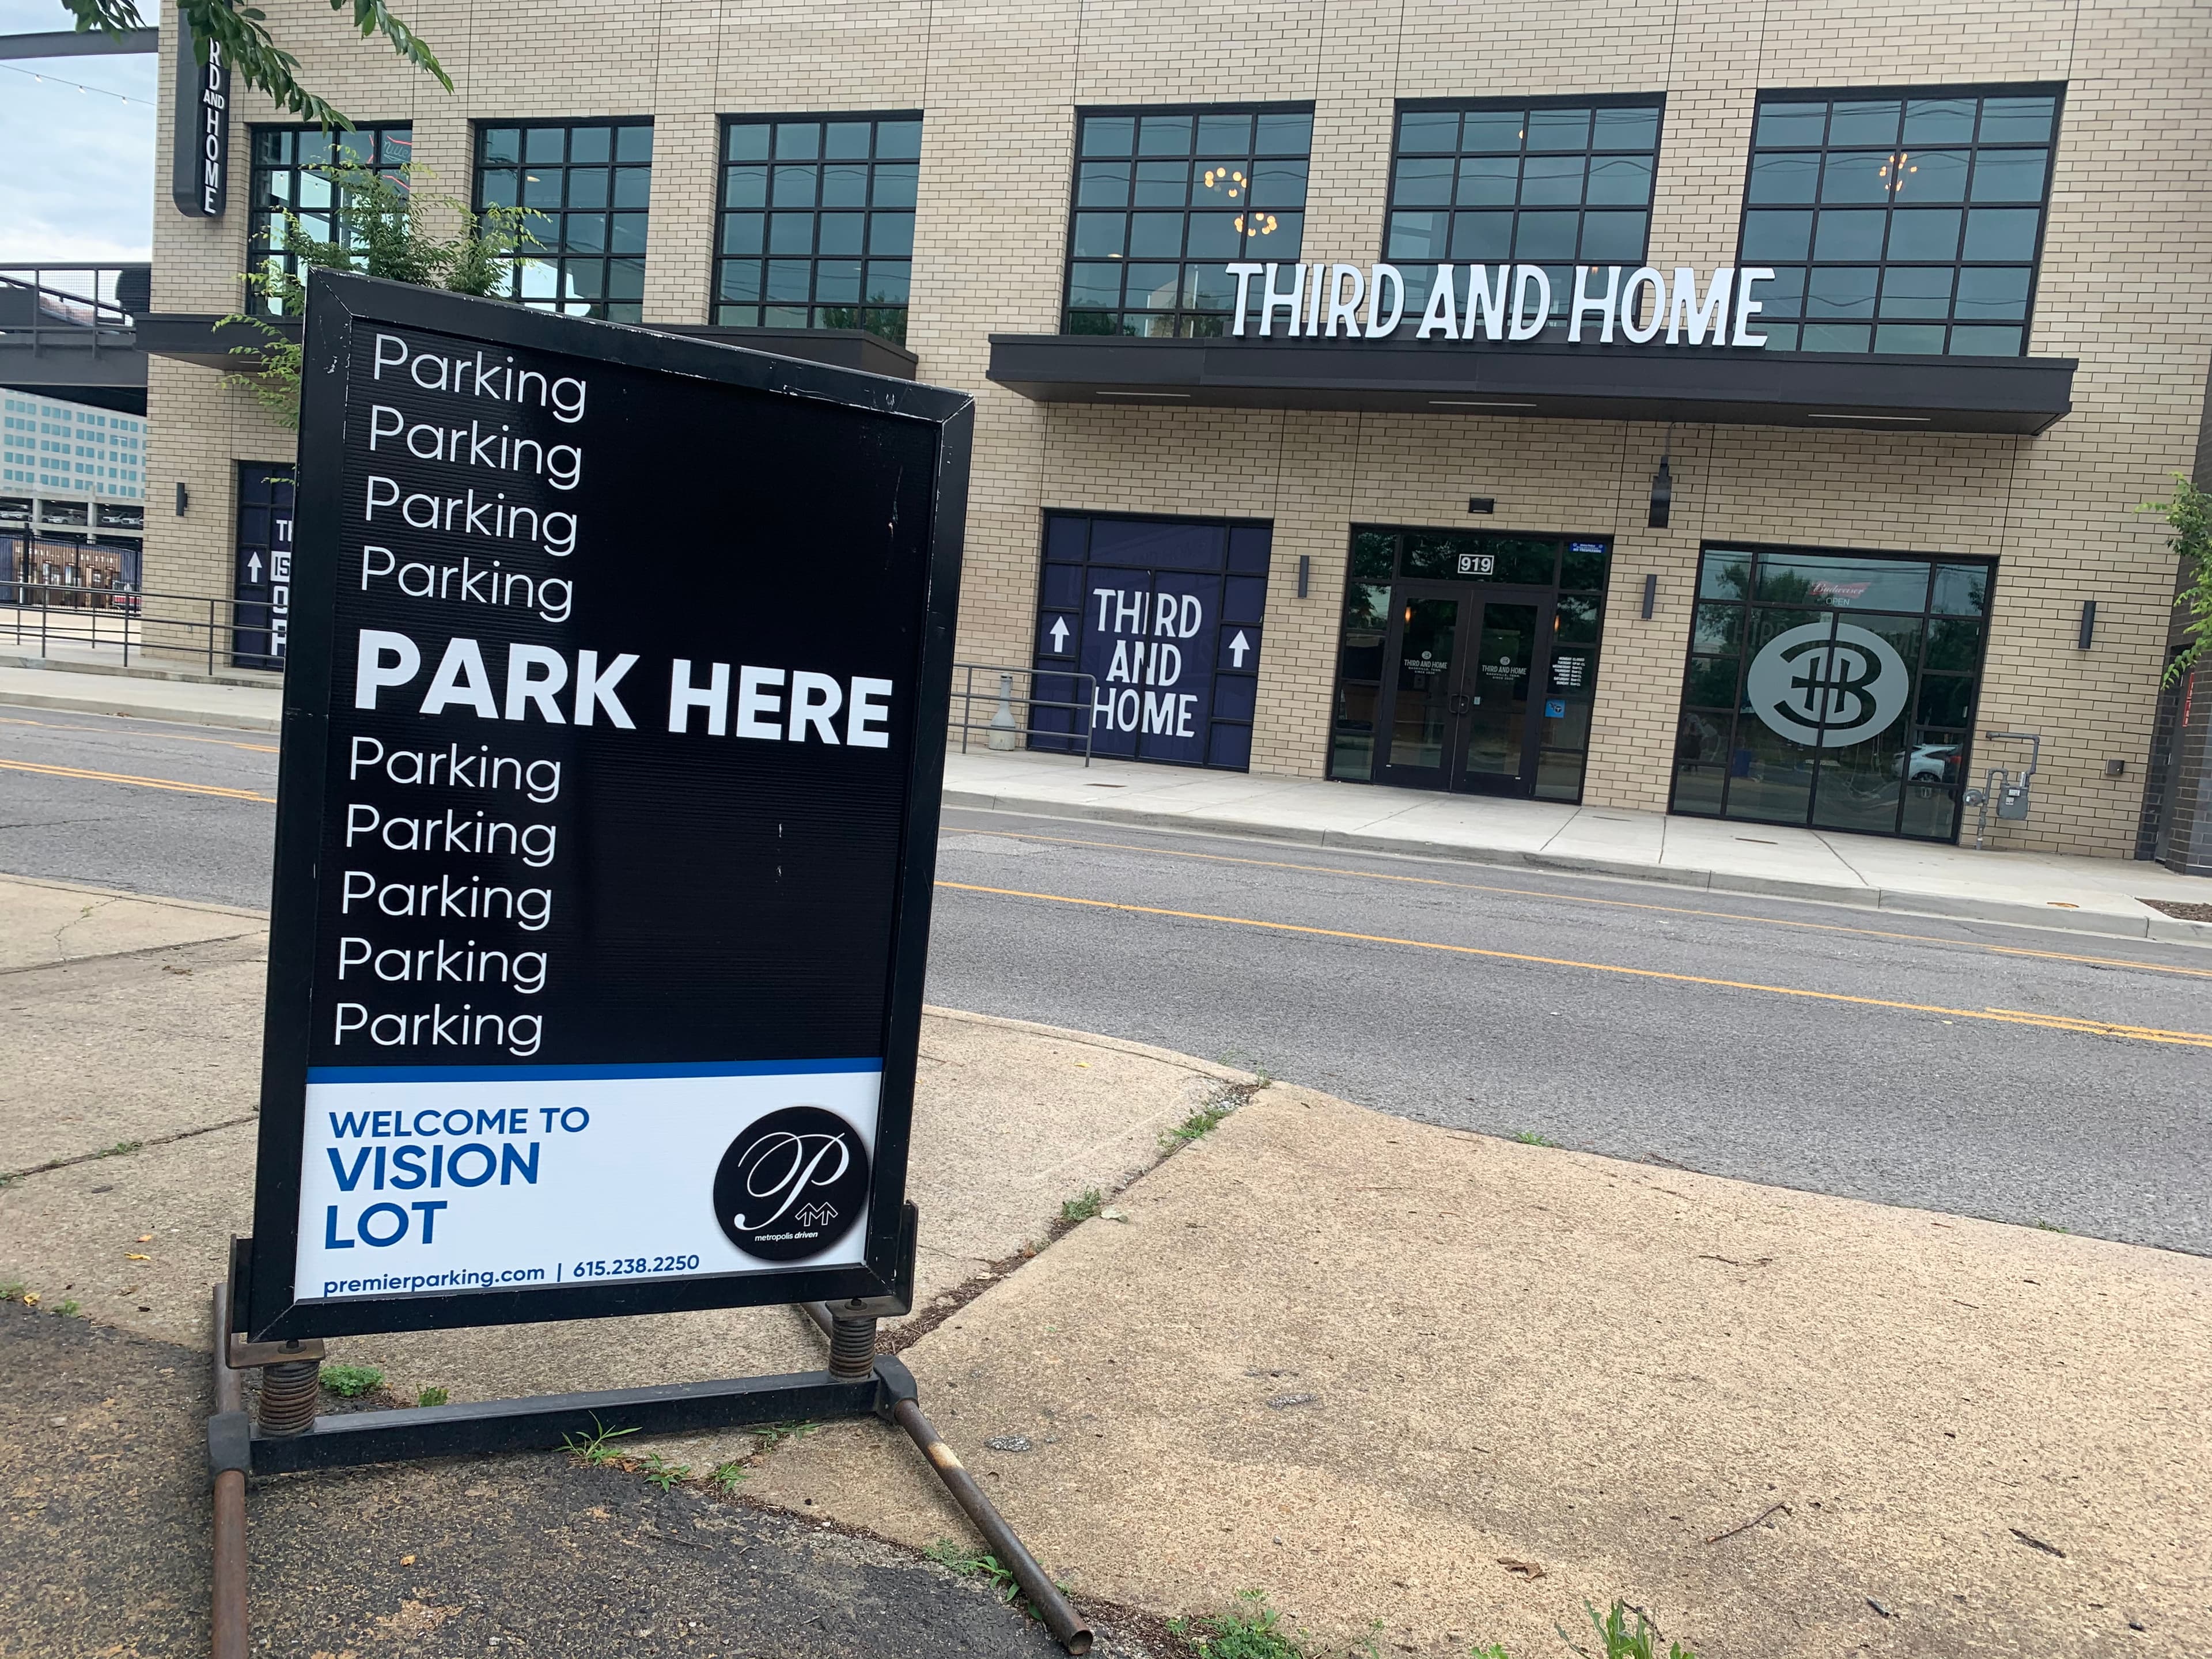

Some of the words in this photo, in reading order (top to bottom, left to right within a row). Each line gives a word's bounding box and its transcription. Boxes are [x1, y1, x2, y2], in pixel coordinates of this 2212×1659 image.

[203, 89, 225, 109] AND
[204, 108, 219, 214] HOME
[1225, 263, 1405, 340] THIRD
[1415, 263, 1552, 342] AND
[1567, 265, 1776, 347] HOME
[372, 334, 586, 423] Parking
[368, 402, 582, 490] Parking
[364, 474, 578, 556] Parking
[361, 544, 573, 623] Parking
[1461, 557, 1491, 572] 919
[1813, 582, 1865, 594] Budweiser
[1093, 589, 1202, 638] THIRD
[1825, 597, 1850, 607] OPEN
[354, 629, 640, 729] PARK
[668, 658, 893, 748] HERE
[1105, 639, 1182, 687] AND
[1092, 686, 1198, 737] HOME
[349, 737, 561, 802] Parking
[347, 804, 556, 867] Parking
[342, 871, 552, 931] Parking
[339, 937, 547, 994] Parking
[335, 1003, 543, 1056] Parking
[329, 1109, 528, 1138] WELCOME
[540, 1107, 590, 1133] TO
[327, 1142, 540, 1192] VISION
[325, 1200, 448, 1249] LOT
[755, 1232, 793, 1242] metropolis
[324, 1268, 545, 1297] premierparking.com
[573, 1255, 700, 1279] 615.238.2250
